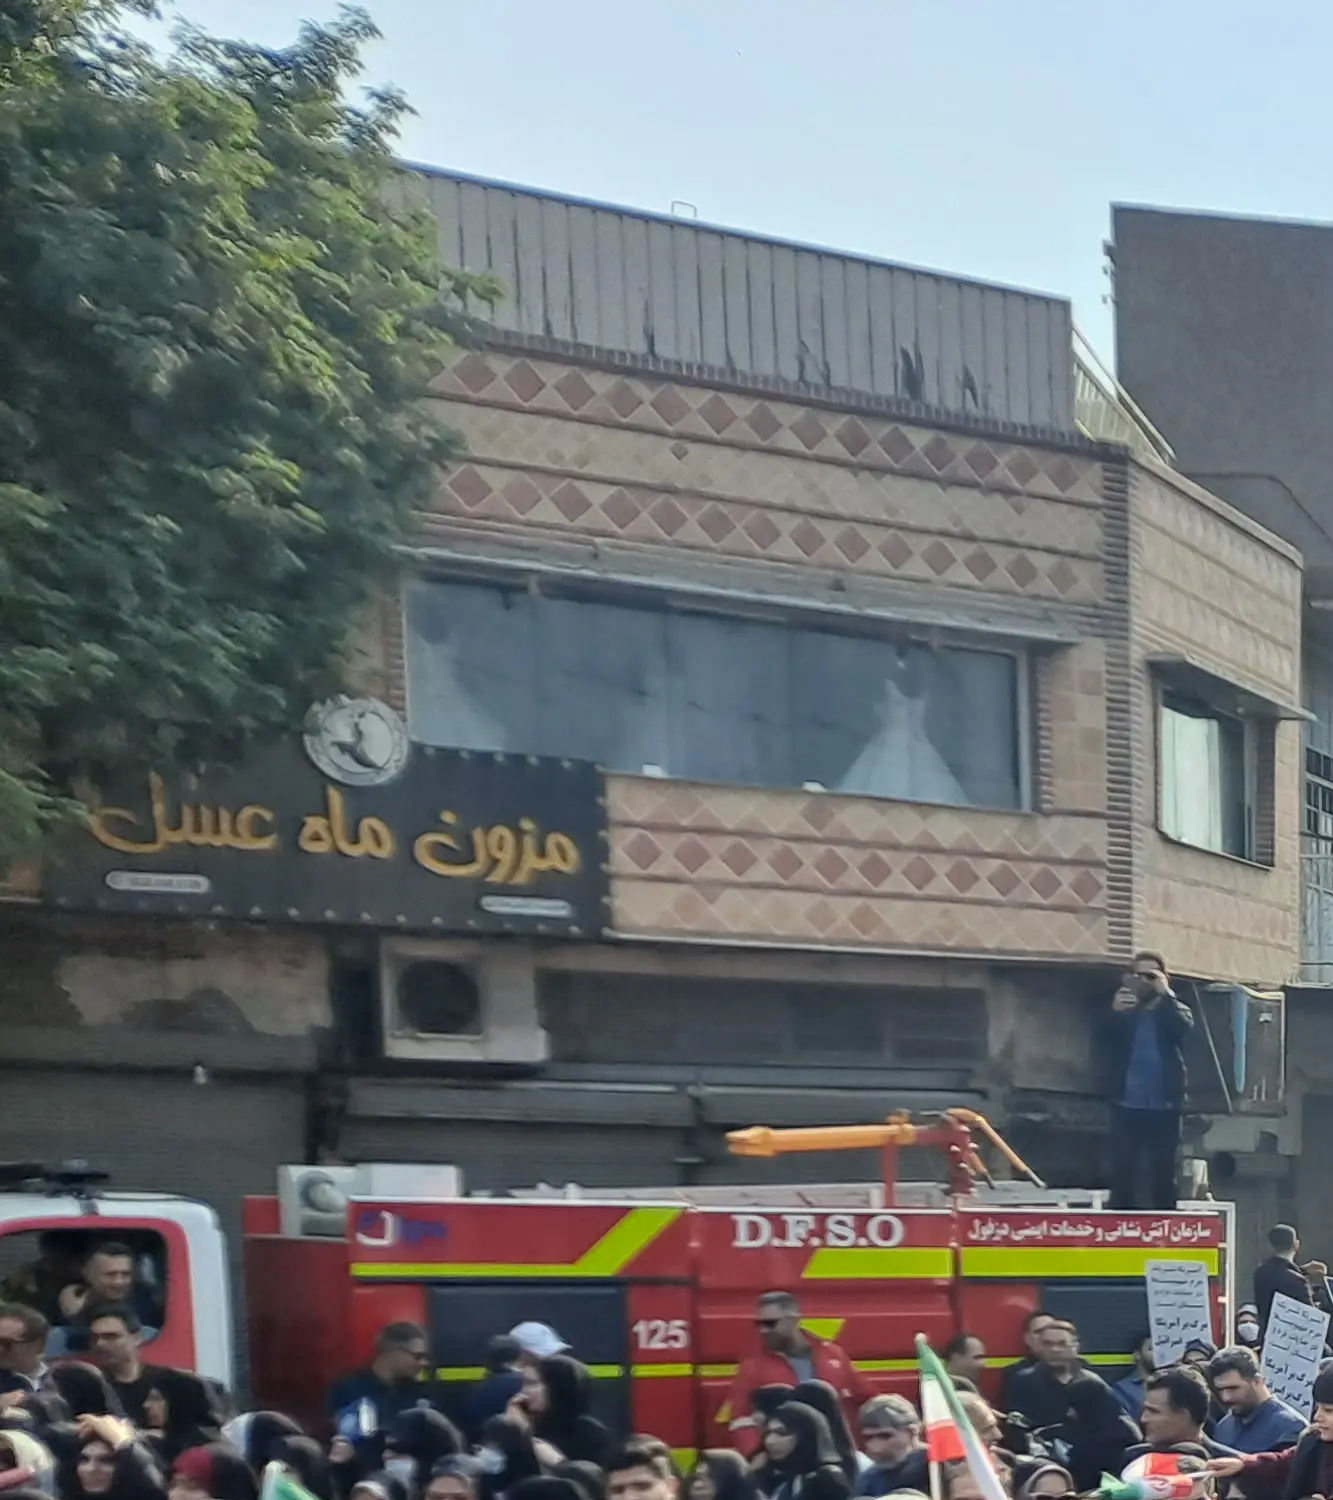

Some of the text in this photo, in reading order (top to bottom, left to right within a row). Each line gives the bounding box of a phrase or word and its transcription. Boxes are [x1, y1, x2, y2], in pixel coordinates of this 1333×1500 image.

[88, 770, 583, 884] مزون ماه عسل
[731, 1214, 905, 1248] D.F.S.O
[967, 1218, 1010, 1242] دزفول
[1009, 1219, 1048, 1242] ایمنی
[1050, 1220, 1095, 1238] خدمات
[1172, 1221, 1212, 1243] سازمان
[632, 1318, 689, 1349] 125
